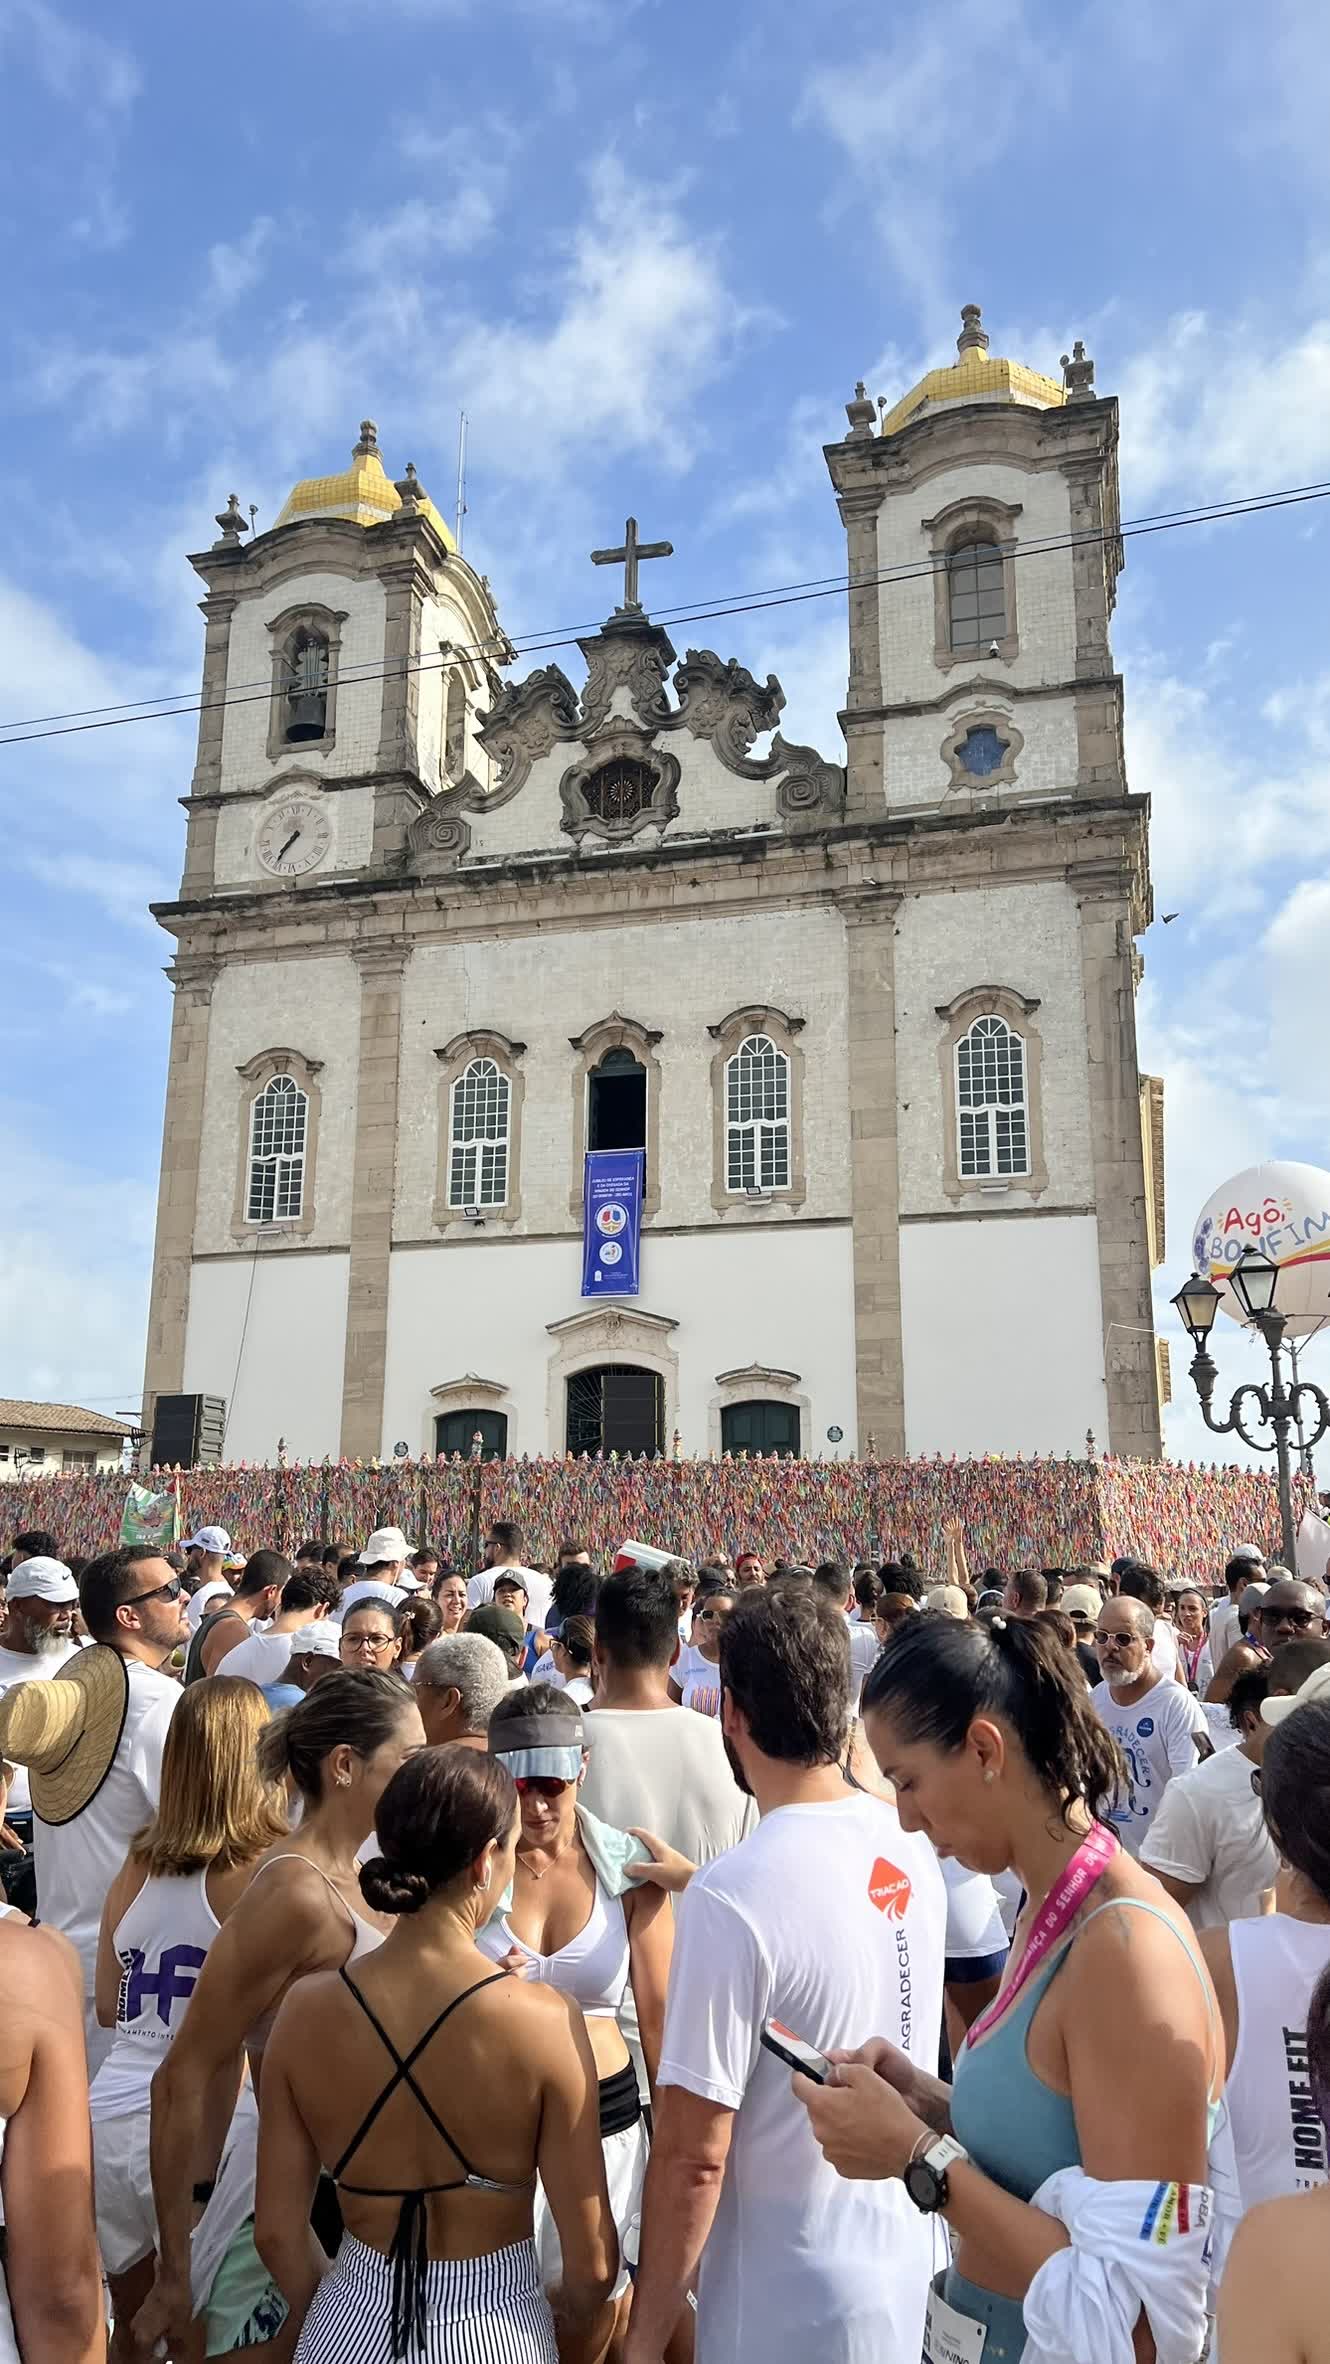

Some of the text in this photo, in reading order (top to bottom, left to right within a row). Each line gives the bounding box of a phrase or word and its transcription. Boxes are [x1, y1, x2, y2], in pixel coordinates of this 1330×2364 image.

[1109, 1726, 1150, 1775] GRADECER
[1045, 1911, 1058, 1929] DO
[1056, 1867, 1088, 1910] SENHOR
[896, 1928, 911, 2051] AGRADECER
[1282, 2026, 1324, 2169] HOME FIT
